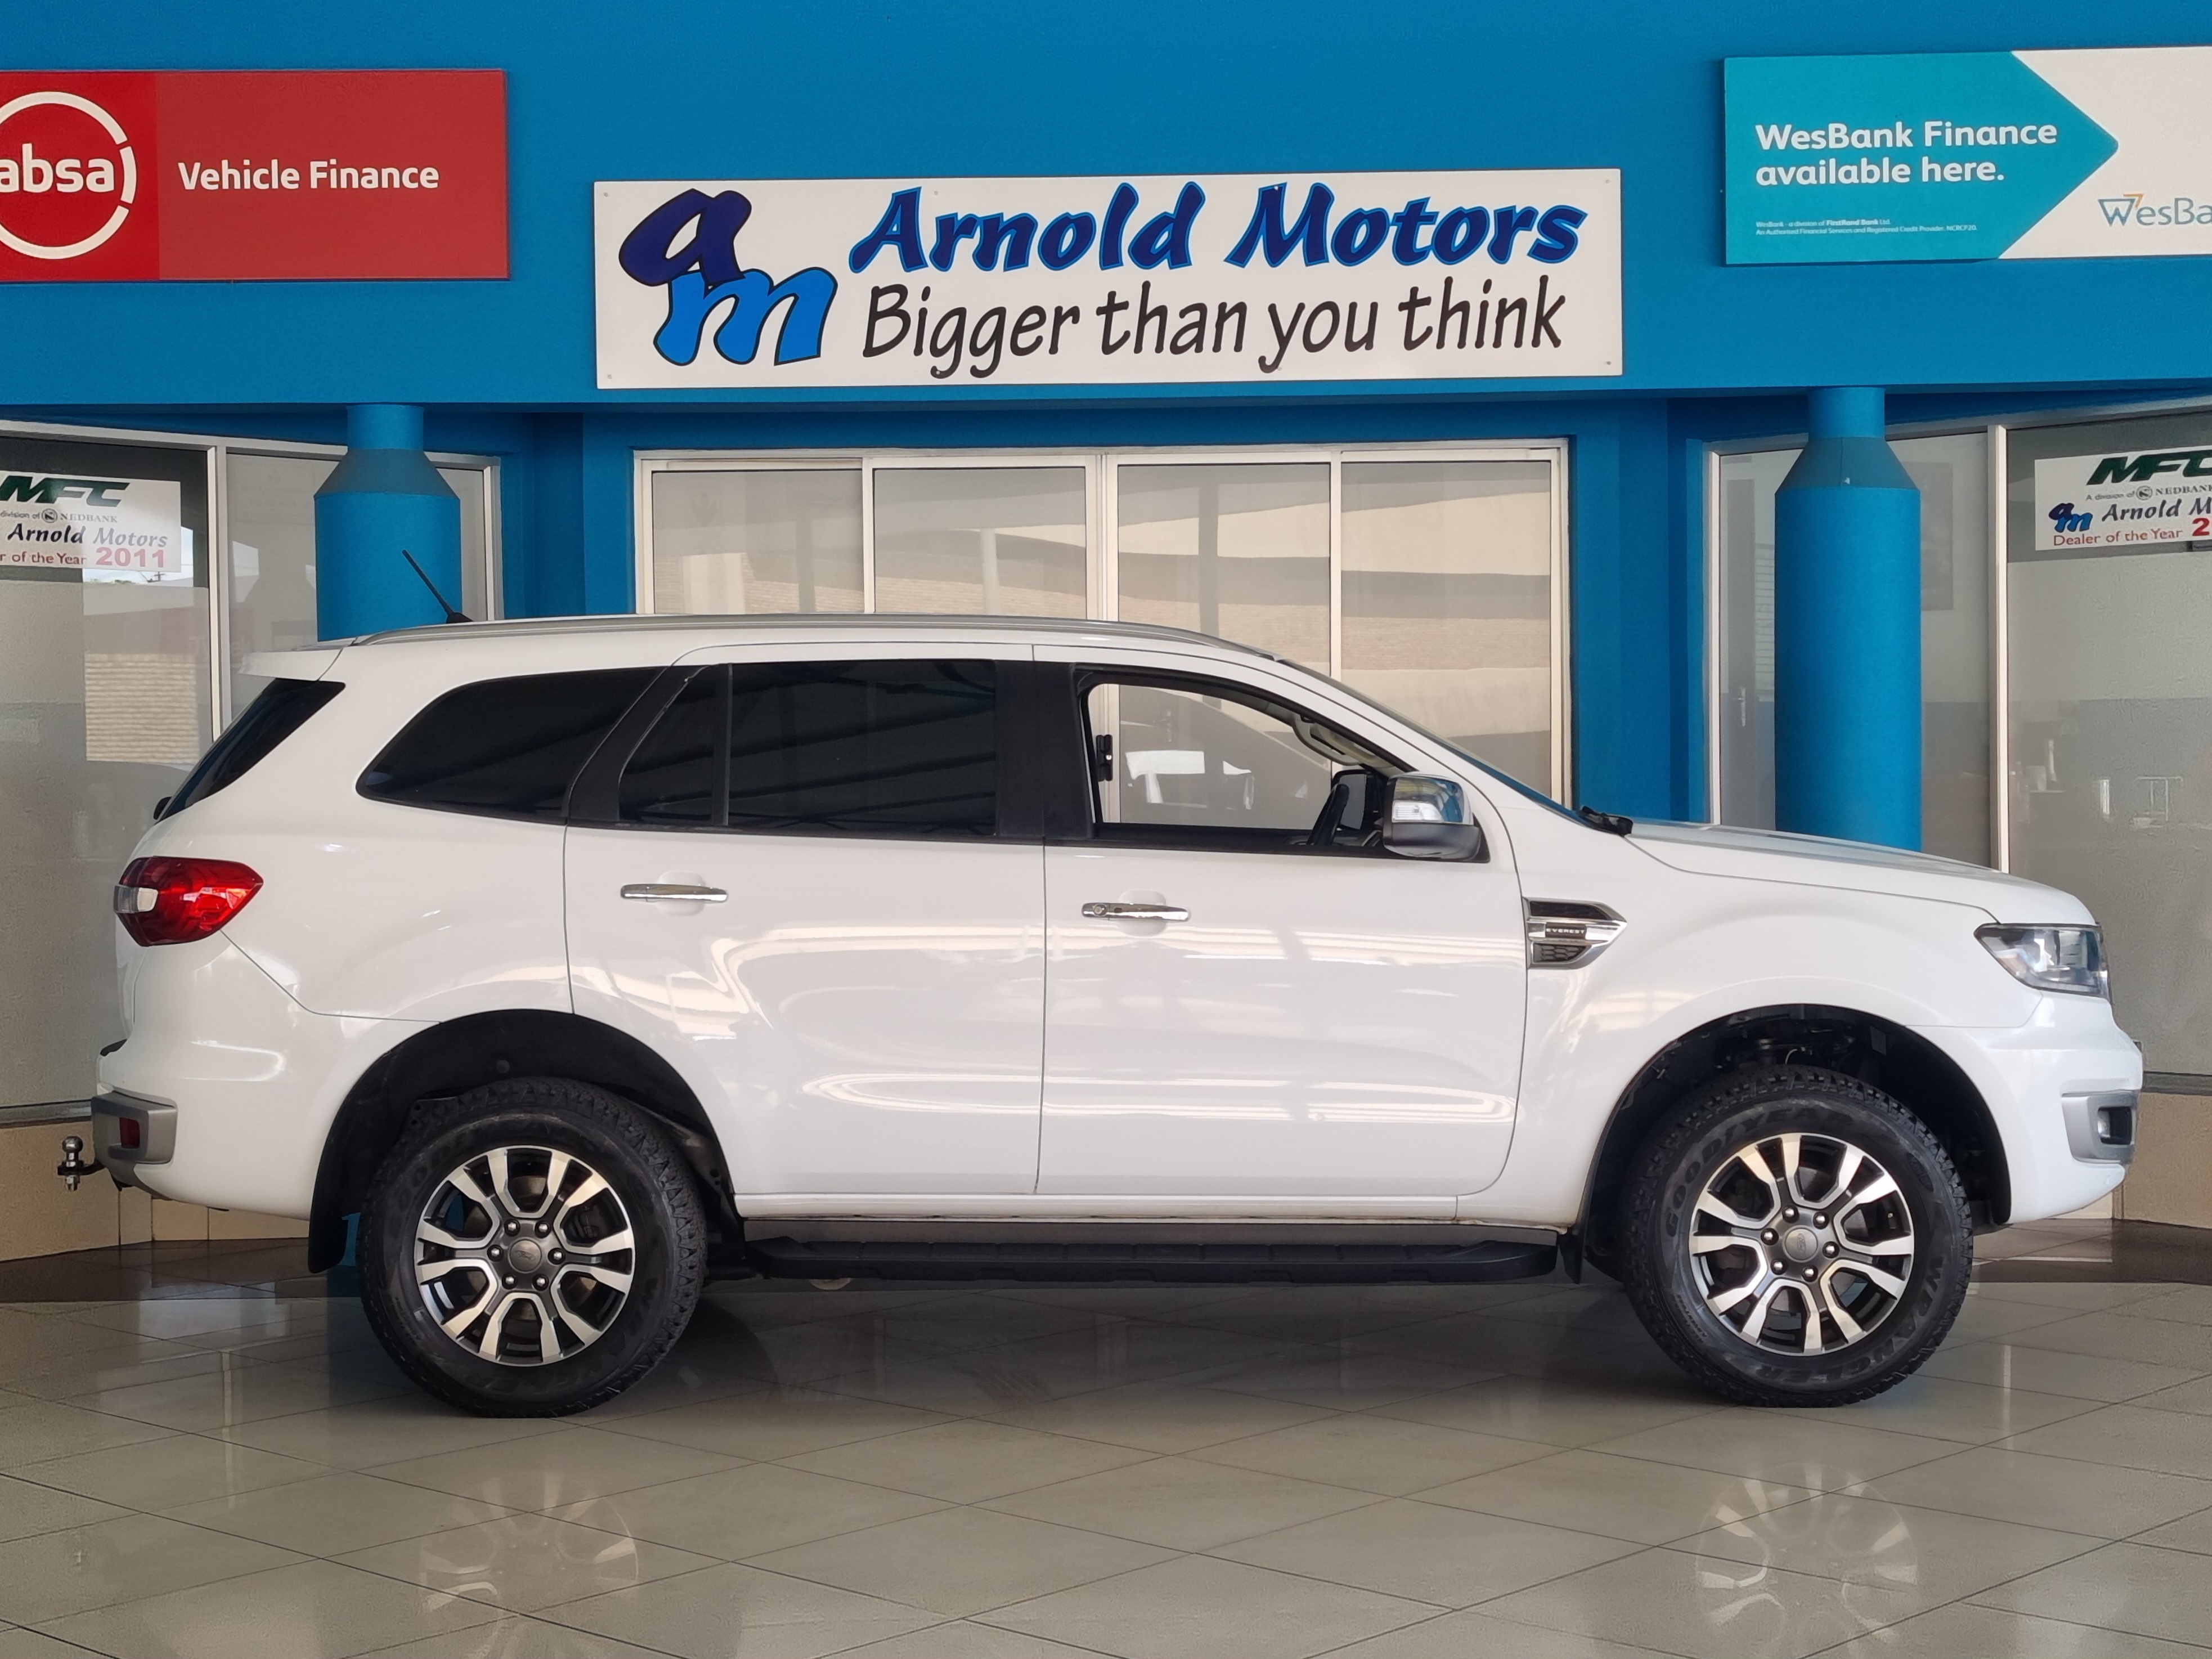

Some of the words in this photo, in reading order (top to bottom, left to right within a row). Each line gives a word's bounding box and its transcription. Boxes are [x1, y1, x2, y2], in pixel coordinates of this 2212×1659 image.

[1755, 122, 1913, 150] WesBank
[1924, 120, 2057, 147] Finance
[0, 143, 114, 192] absa
[178, 159, 300, 190] Vehicle
[310, 158, 439, 189] Finance
[1756, 156, 1911, 186] available
[1922, 156, 2004, 183] here.
[849, 181, 1206, 273] Arnold
[1224, 181, 1588, 268] Motors
[863, 284, 1079, 379] Bigger
[1096, 280, 1248, 355] than
[1258, 301, 1378, 374] you
[1398, 275, 1566, 351] think
[0, 475, 131, 507] MFC
[60, 513, 118, 523] NEDBANK
[2102, 499, 2182, 521] Arnold
[7, 523, 87, 544] Arnold
[93, 527, 168, 548] Motors
[2054, 533, 2101, 546] Dealer
[2106, 530, 2121, 542] of
[2125, 530, 2148, 541] the
[2151, 528, 2183, 540] Year
[12, 551, 27, 562] of
[32, 552, 54, 563] the
[57, 553, 87, 564] Year
[96, 546, 164, 568] 2011
